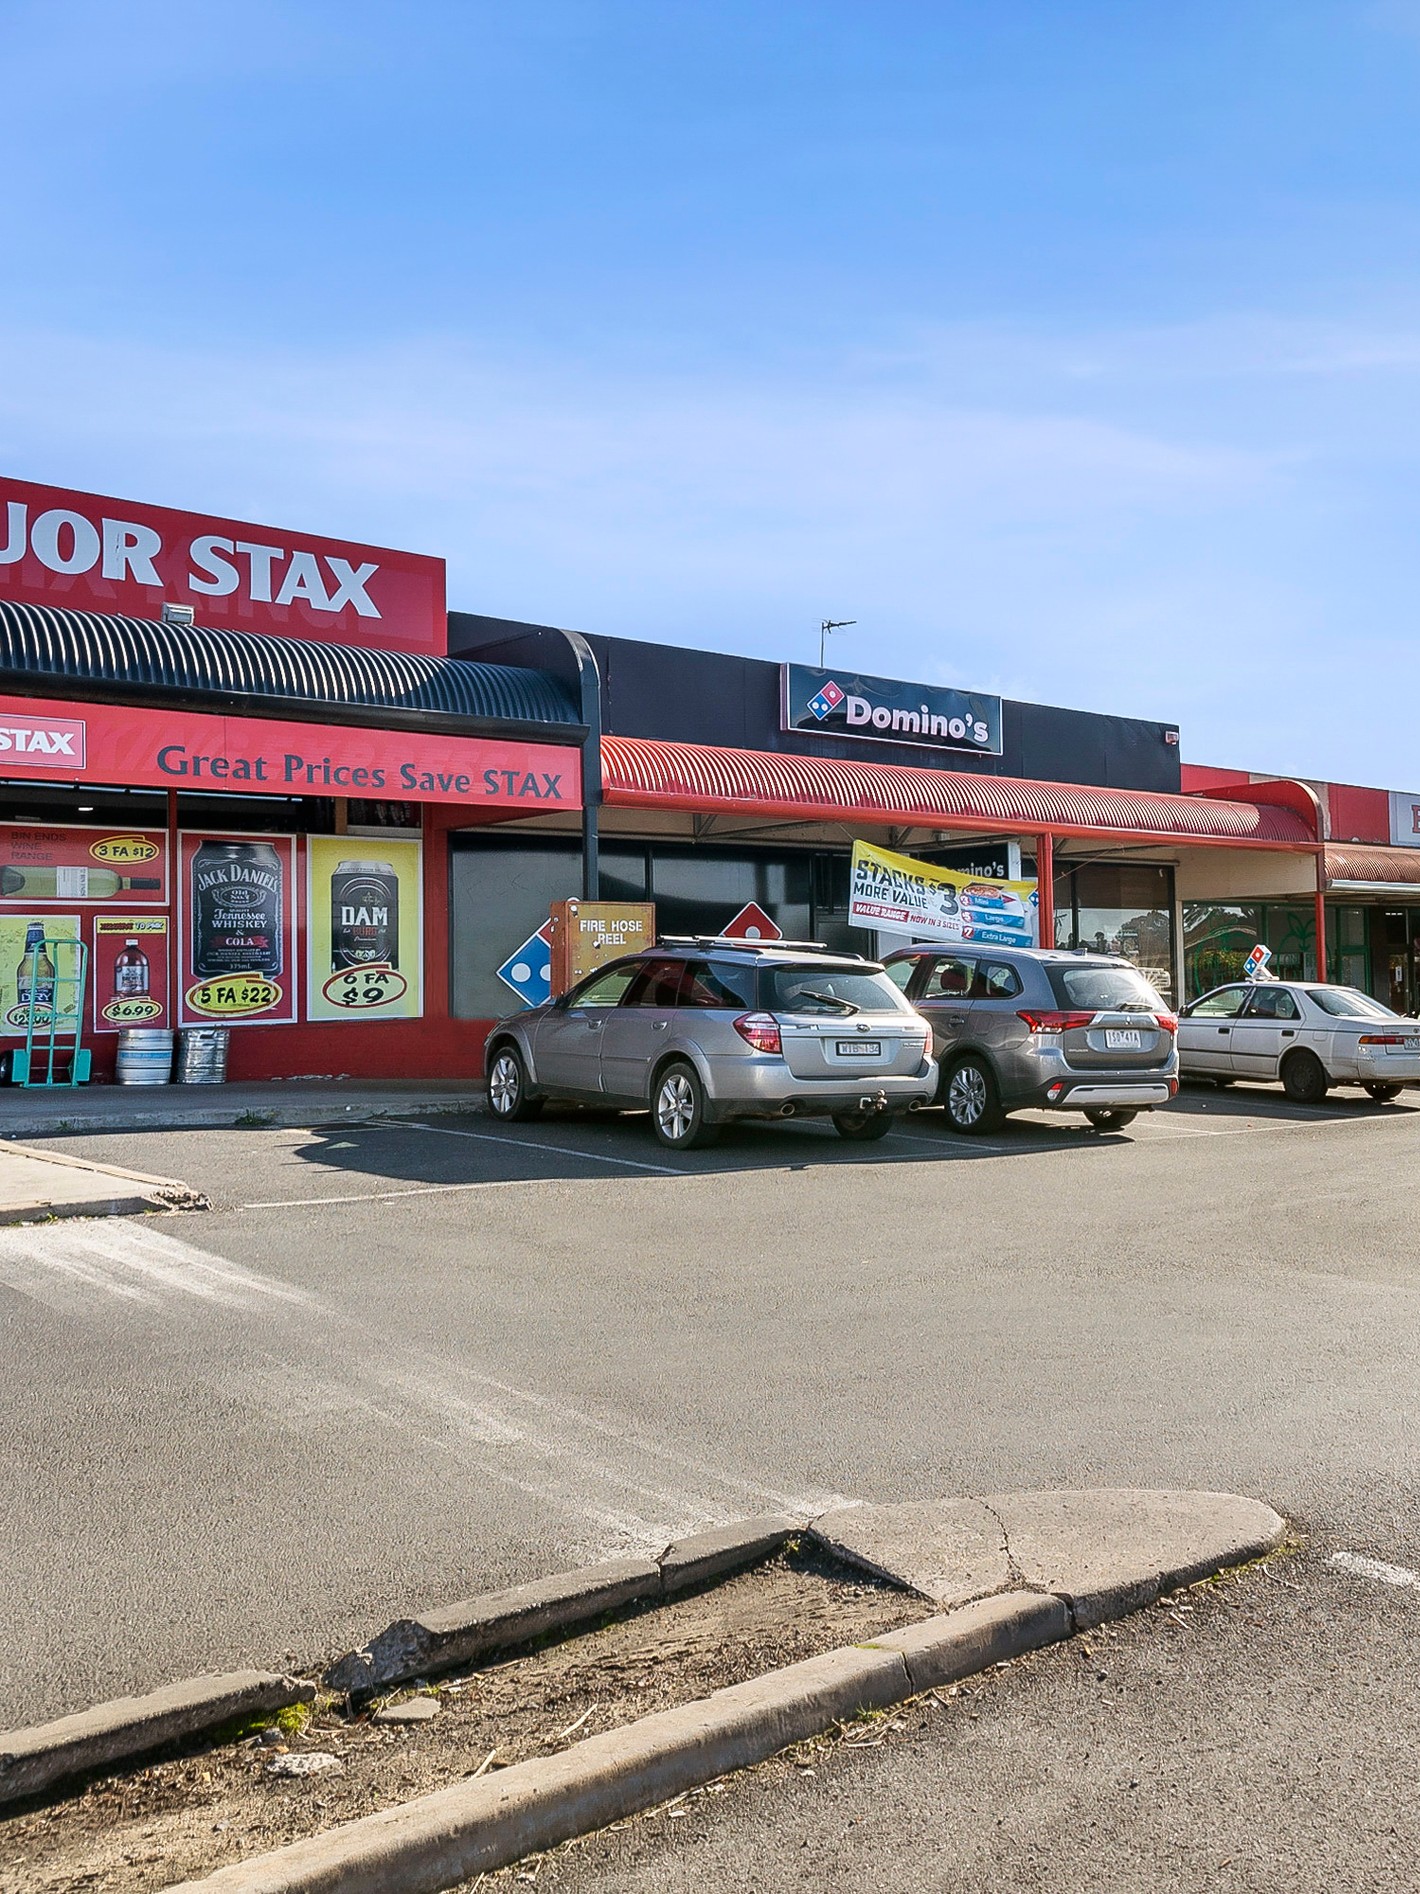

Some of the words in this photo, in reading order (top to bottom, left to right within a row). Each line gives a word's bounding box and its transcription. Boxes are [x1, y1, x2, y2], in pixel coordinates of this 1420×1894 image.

[188, 534, 383, 619] STAX
[846, 695, 990, 743] Domino's
[157, 744, 268, 782] Great
[283, 754, 387, 789] Prices
[400, 762, 471, 794] Save
[482, 767, 563, 800] STAX
[99, 845, 108, 856] 3
[113, 846, 129, 857] FA
[133, 847, 155, 859] $12
[197, 867, 227, 891] JACK
[231, 864, 279, 892] DANIEL'S
[856, 859, 926, 896] STACKS
[853, 881, 889, 901] MORE
[892, 887, 929, 909] VALUE
[214, 908, 266, 920] Tennessee
[341, 906, 388, 926] DAM
[855, 904, 881, 916] VALUE
[881, 908, 908, 922] RANGE
[211, 920, 268, 928] WHISKEY
[579, 920, 606, 932] FIRE
[611, 920, 643, 932] HOSE
[910, 915, 927, 925] NOW
[928, 918, 936, 926] IN
[942, 921, 960, 930] SIZES
[225, 937, 255, 946] COLA
[597, 933, 627, 945] REEL
[981, 931, 998, 941] Extra
[999, 934, 1017, 944] Large
[343, 972, 357, 985] 6
[364, 973, 390, 985] FA
[200, 988, 211, 1004] 5
[216, 988, 237, 1004] FA
[241, 987, 272, 1003] $22
[341, 986, 385, 1006] $9
[111, 1004, 154, 1017] $6.99
